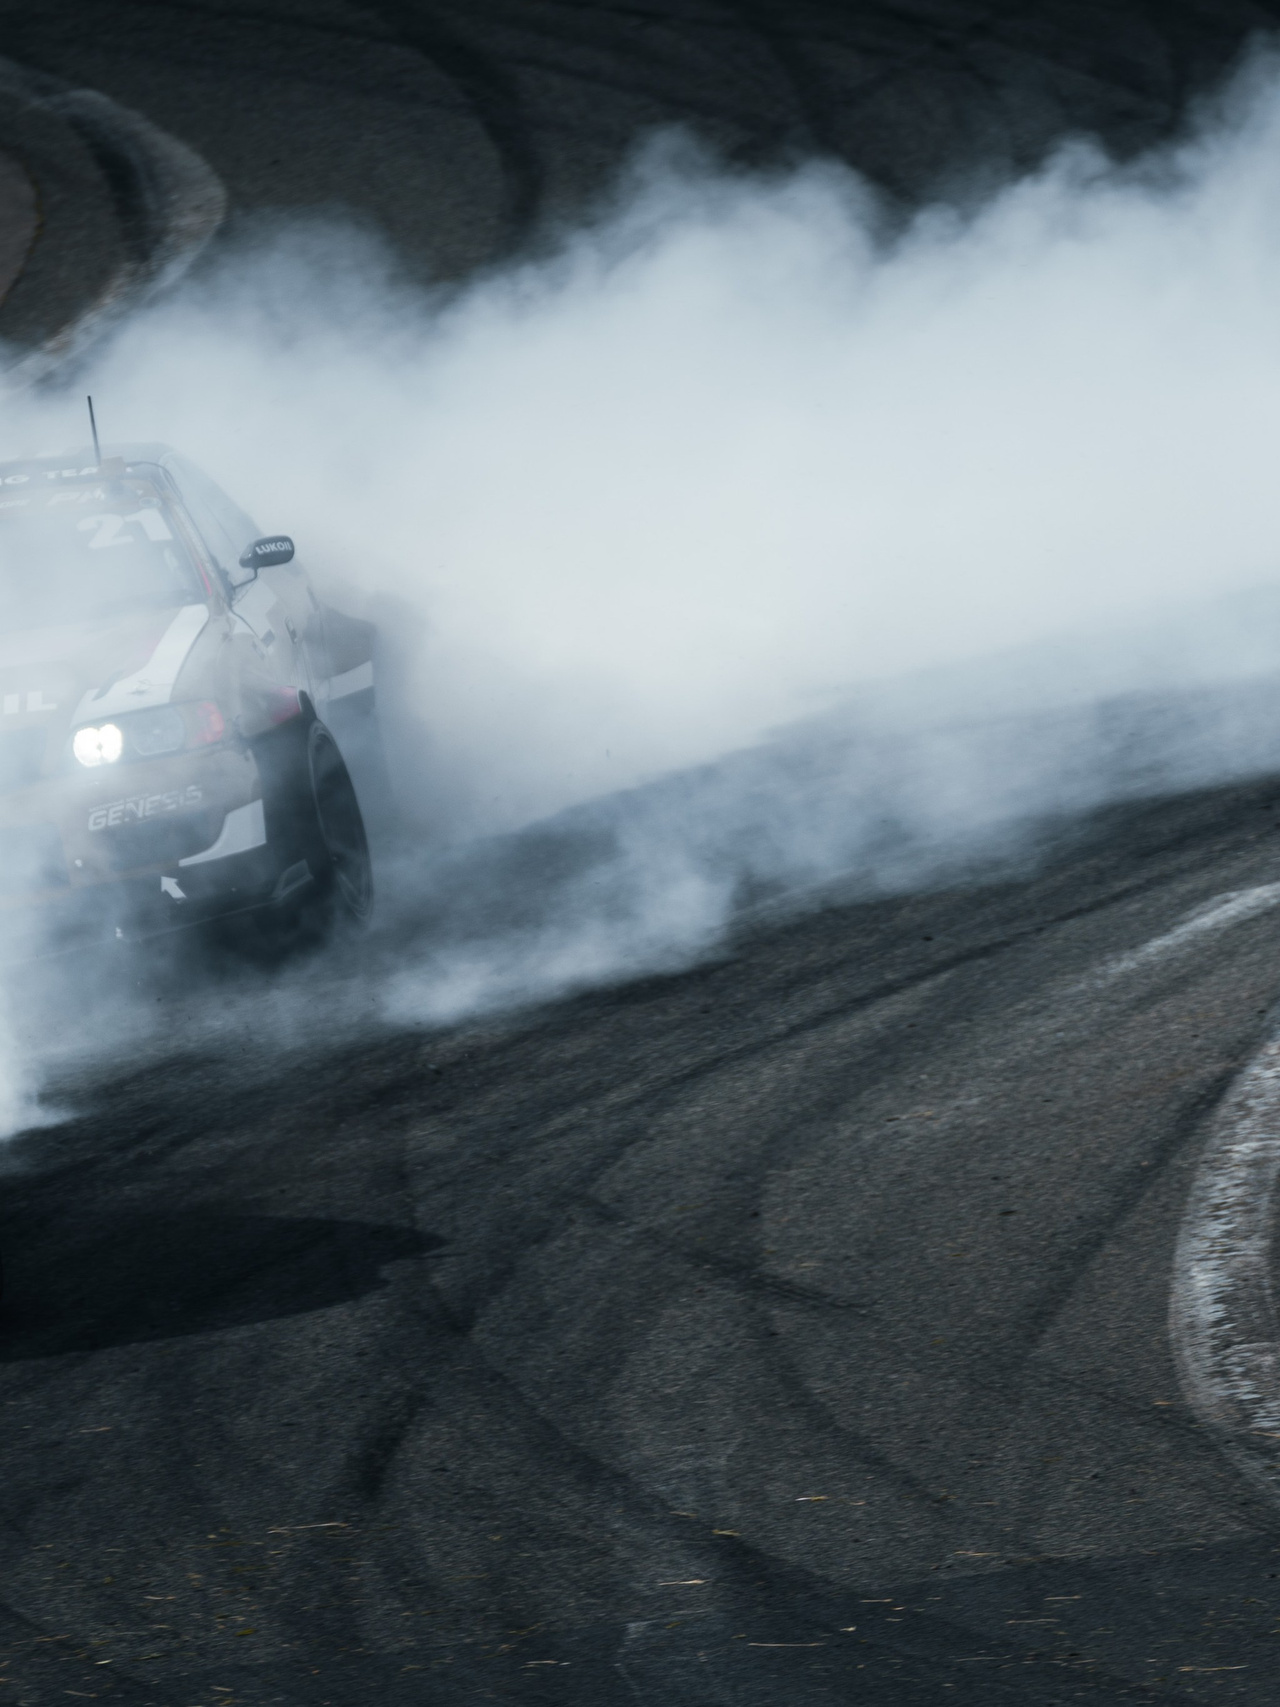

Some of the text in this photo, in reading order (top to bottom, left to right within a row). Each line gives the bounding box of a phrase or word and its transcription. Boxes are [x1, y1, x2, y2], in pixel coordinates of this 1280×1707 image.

[42, 465, 122, 480] TEA
[76, 508, 173, 549] 21
[87, 785, 202, 831] GENESIS
